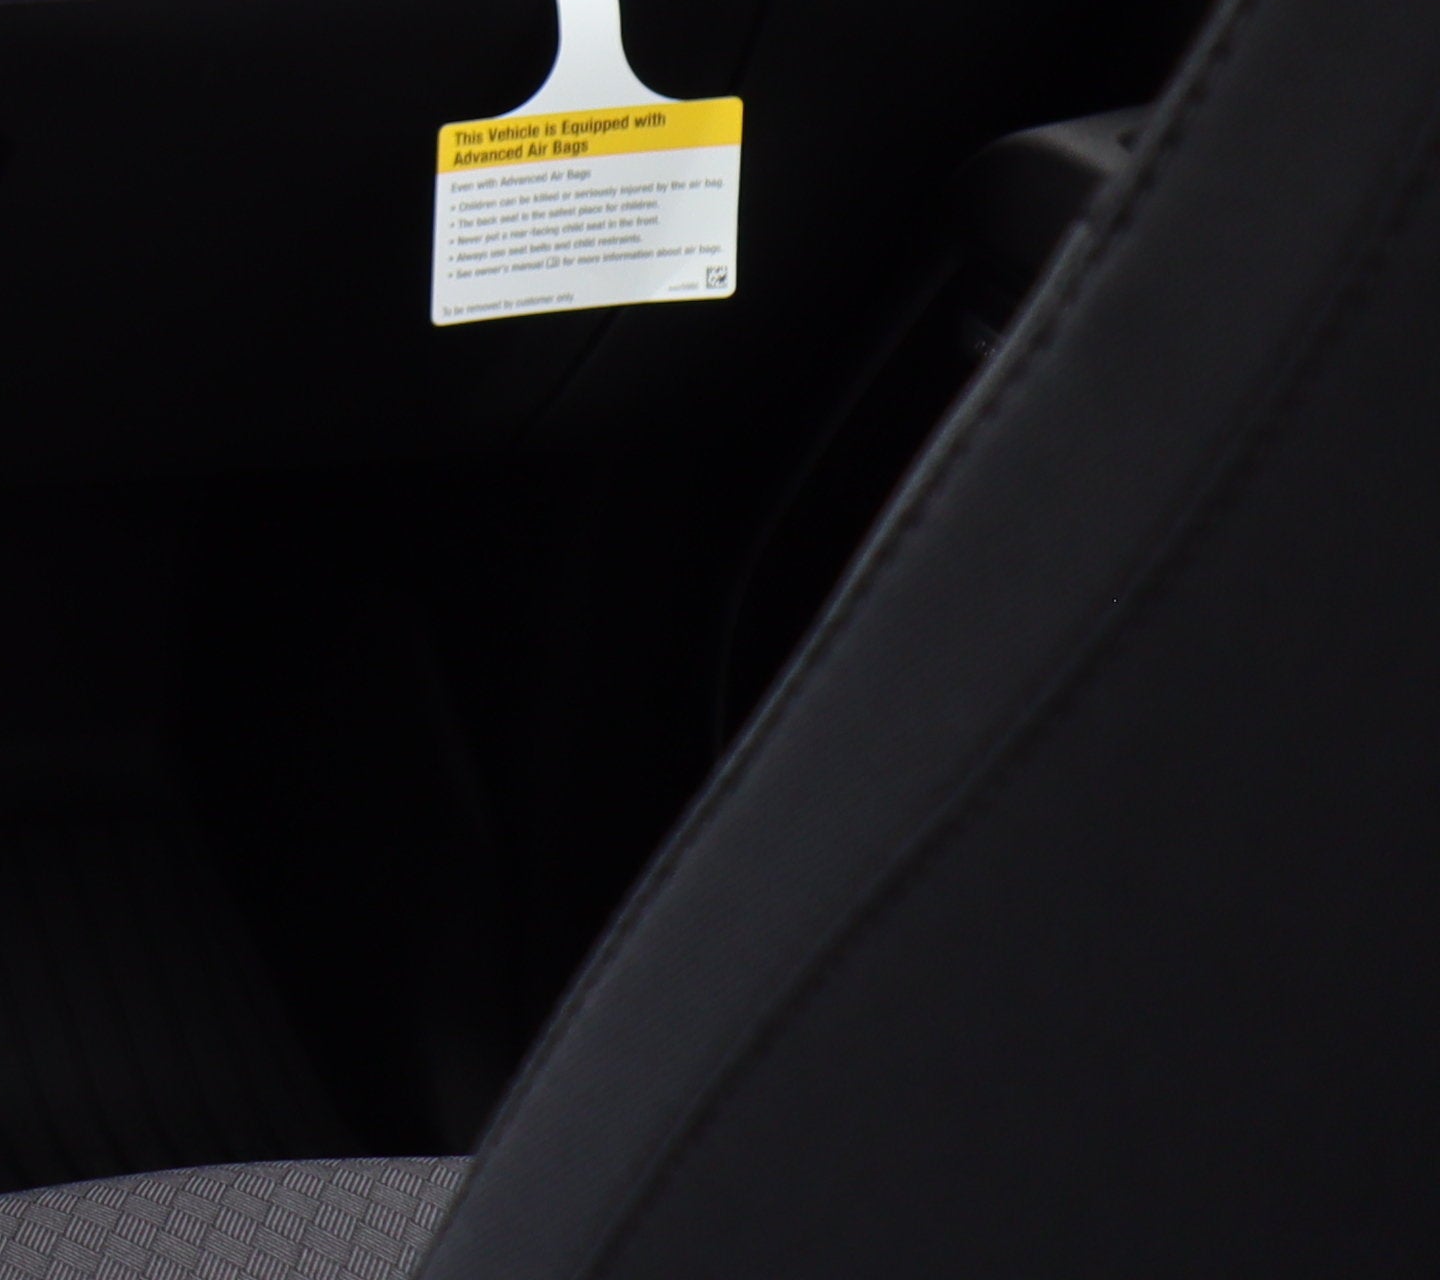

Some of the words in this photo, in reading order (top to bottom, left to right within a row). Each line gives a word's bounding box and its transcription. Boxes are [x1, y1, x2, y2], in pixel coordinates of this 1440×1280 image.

[456, 130, 482, 145] This
[489, 125, 539, 141] Vehicle
[546, 123, 556, 136] is
[562, 117, 629, 135] Equipped
[635, 113, 665, 128] with
[454, 146, 522, 165] Advanced
[528, 143, 548, 157] Air
[553, 139, 588, 156] Bags
[452, 180, 474, 192] Even
[477, 178, 497, 189] with
[501, 172, 548, 186] Advanced
[551, 170, 563, 181] Air
[567, 167, 591, 180] Bags
